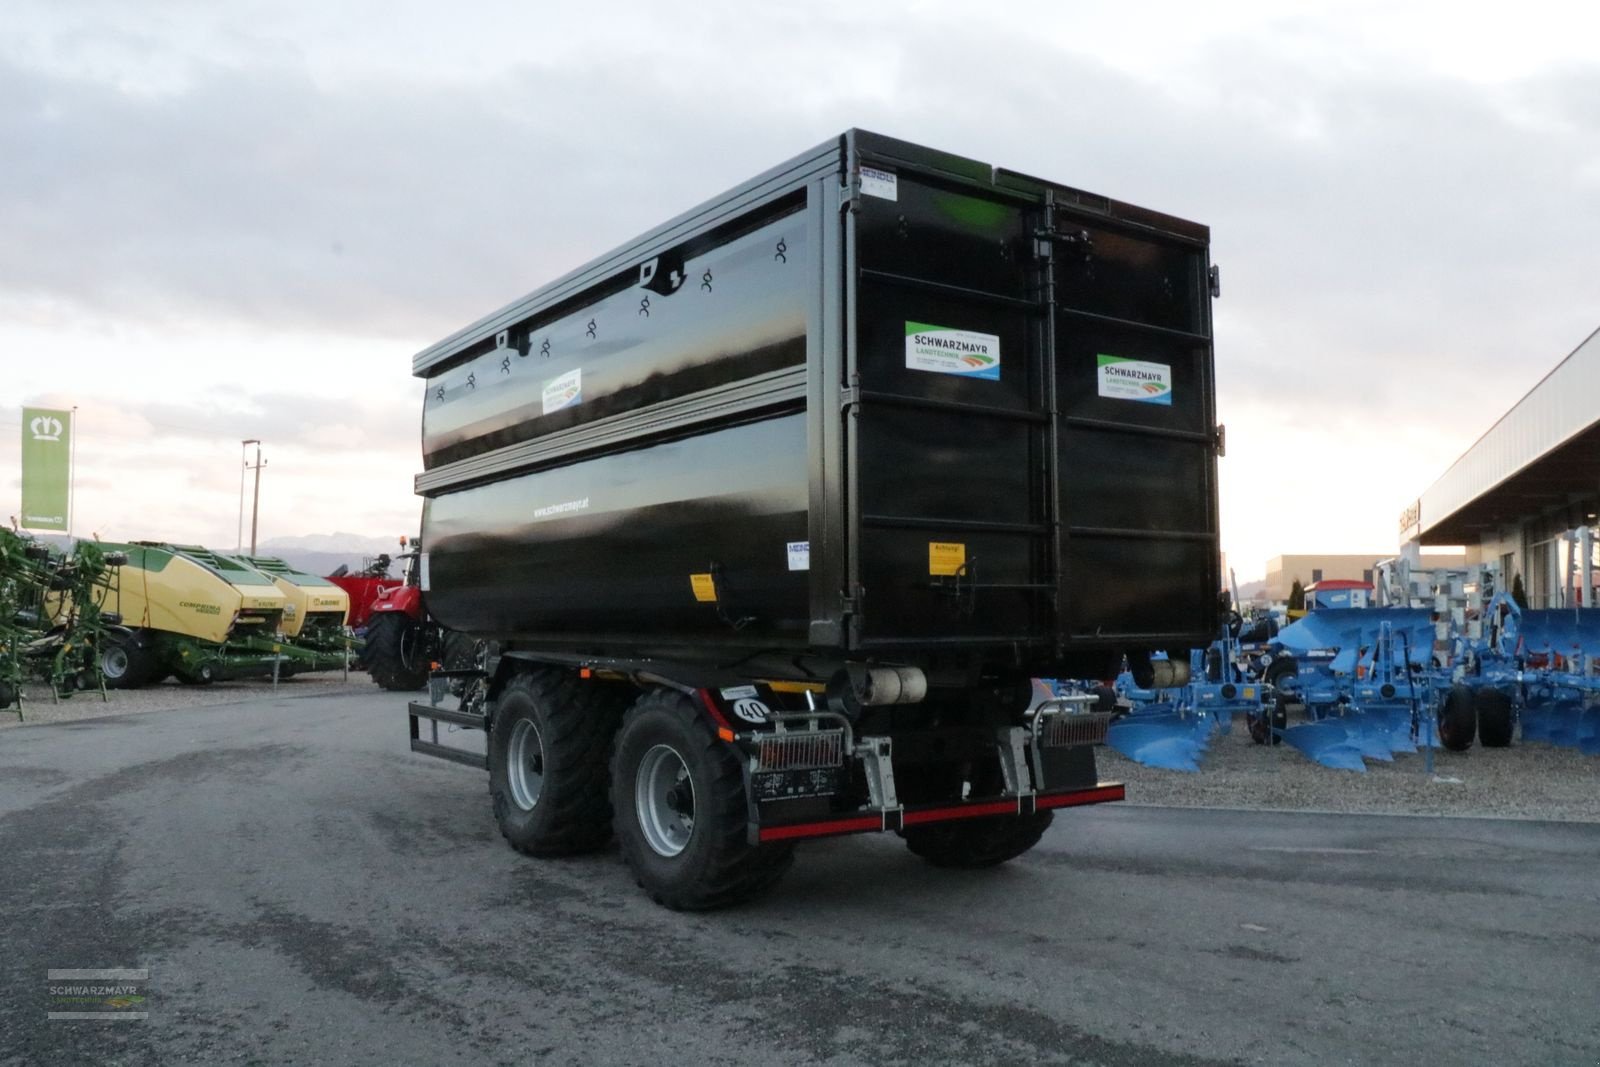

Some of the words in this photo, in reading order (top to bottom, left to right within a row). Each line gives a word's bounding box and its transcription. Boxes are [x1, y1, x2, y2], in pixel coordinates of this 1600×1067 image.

[914, 335, 988, 354] SCHWARZMAYR
[916, 347, 960, 360] LANDTECHNIK
[1105, 366, 1162, 382] SCHWARZMAYR
[179, 601, 221, 611] COMPRIMA
[739, 702, 766, 719] 40
